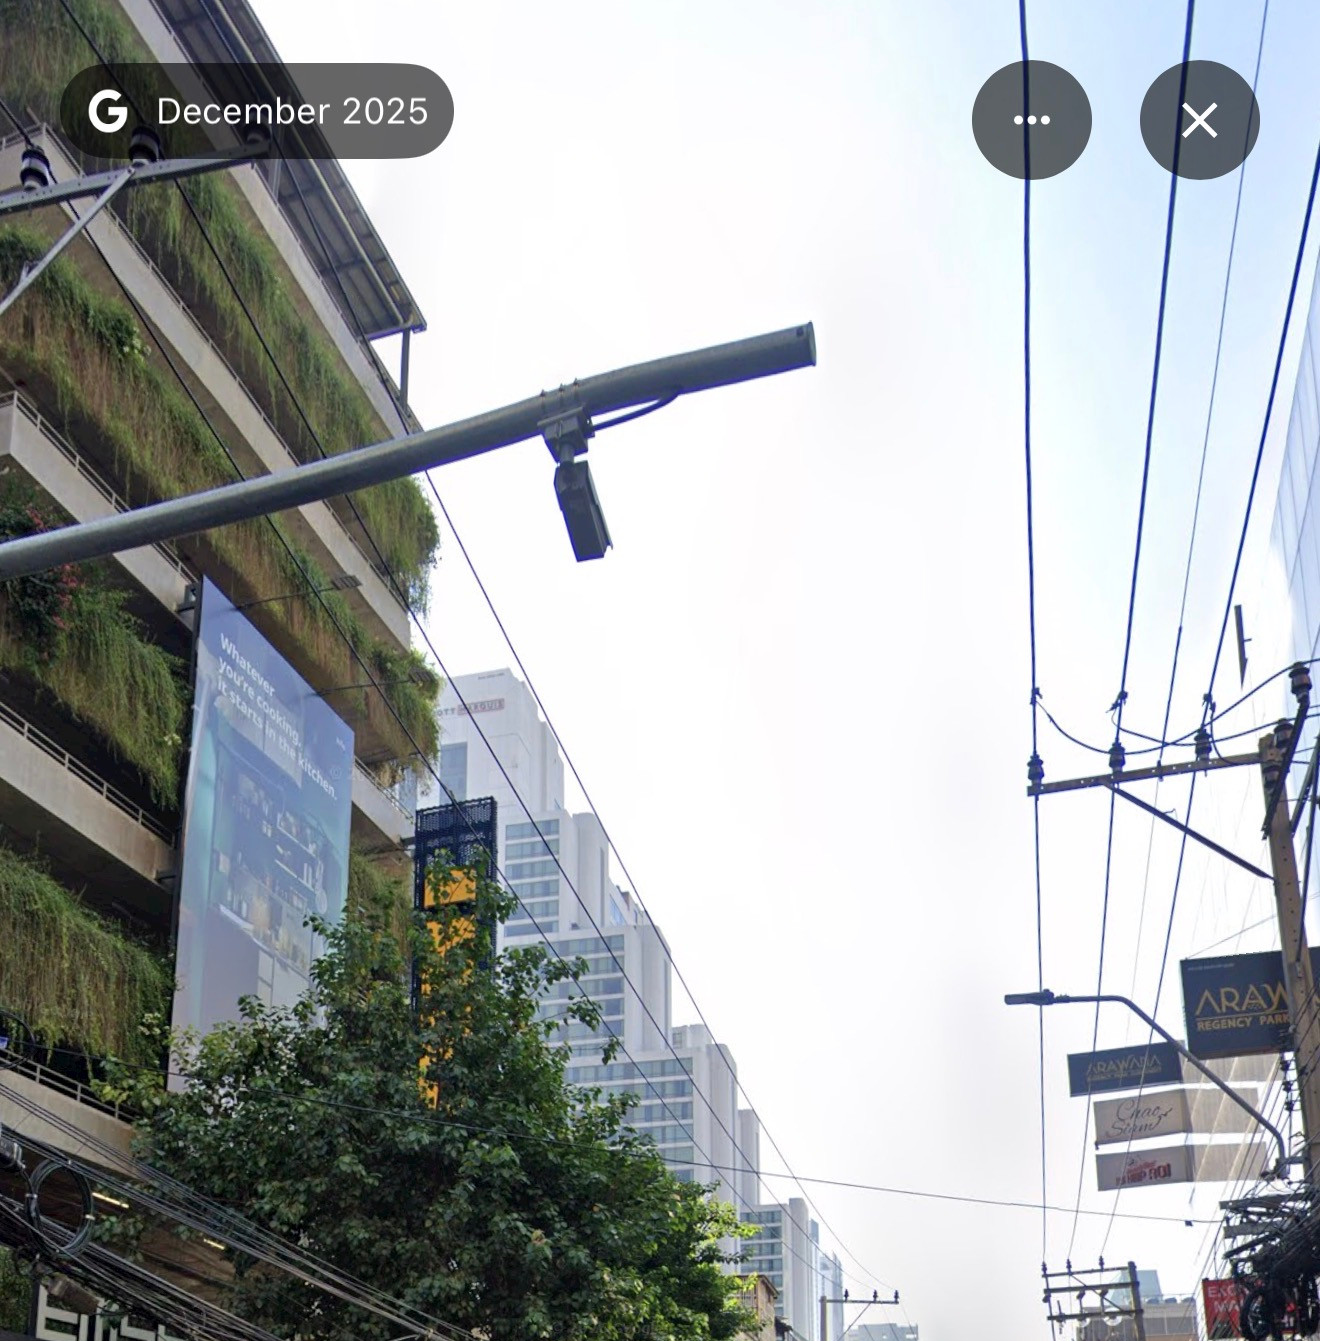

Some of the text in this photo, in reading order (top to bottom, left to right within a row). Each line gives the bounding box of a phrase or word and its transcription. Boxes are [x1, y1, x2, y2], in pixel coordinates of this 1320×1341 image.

[218, 656, 255, 700] you're
[221, 633, 276, 697] Whatever
[229, 692, 263, 729] starts
[265, 721, 276, 742] in
[279, 736, 296, 761] the
[298, 751, 338, 801] kitchen.
[1197, 1016, 1253, 1031] REGENCY
